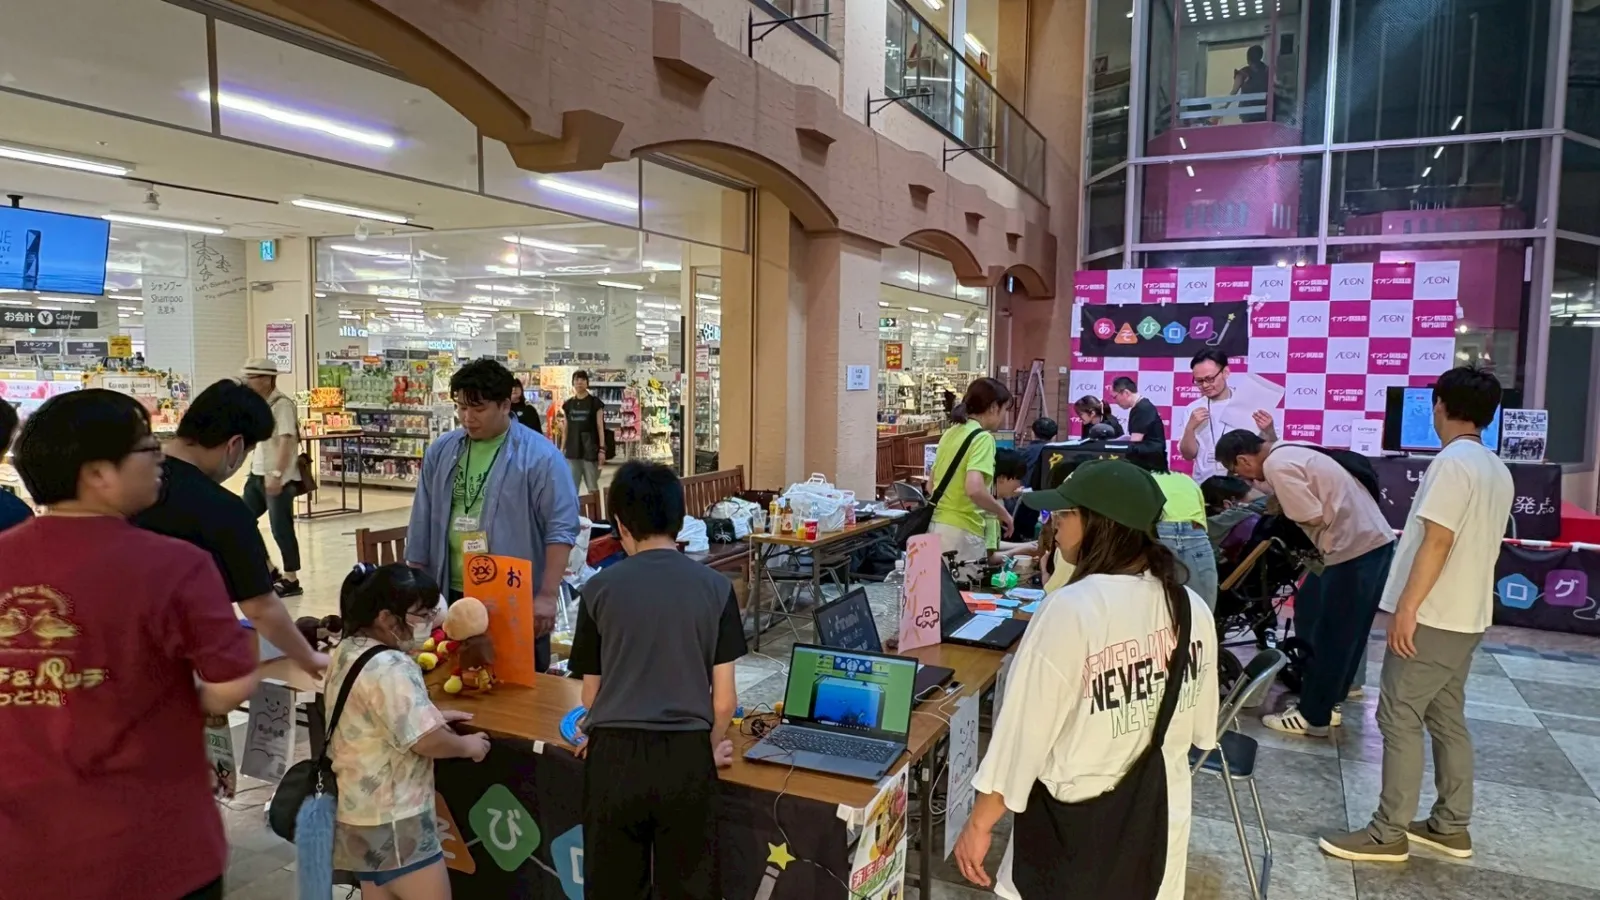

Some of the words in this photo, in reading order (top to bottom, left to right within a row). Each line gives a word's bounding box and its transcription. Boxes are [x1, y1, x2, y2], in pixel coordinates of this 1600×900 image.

[150, 294, 184, 304] Shampoo
[4, 311, 35, 323] お会計
[55, 313, 82, 321] Casher
[1098, 320, 1209, 342] あそびログ
[507, 566, 523, 589] お
